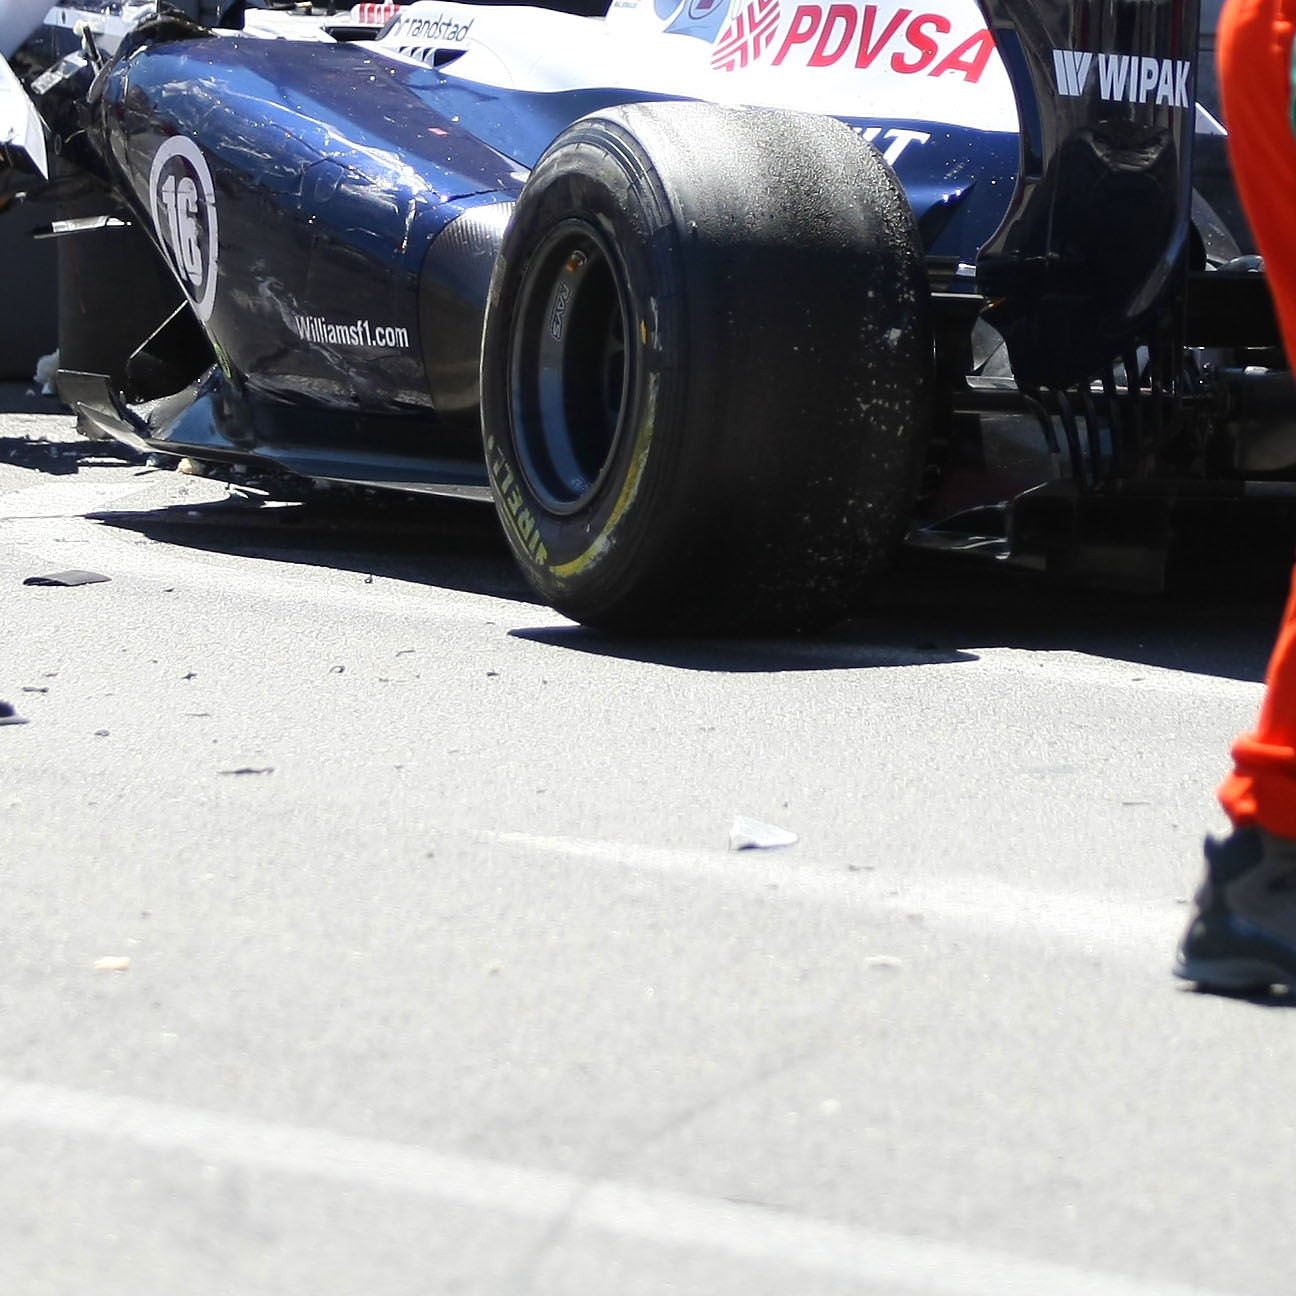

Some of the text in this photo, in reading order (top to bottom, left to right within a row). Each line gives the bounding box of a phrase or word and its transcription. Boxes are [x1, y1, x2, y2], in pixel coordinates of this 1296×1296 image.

[407, 12, 475, 42] randstad
[771, 3, 998, 84] PDVSA
[1098, 53, 1191, 109] WIPAK
[161, 174, 203, 287] 16
[295, 315, 409, 348] Williamsf1.com
